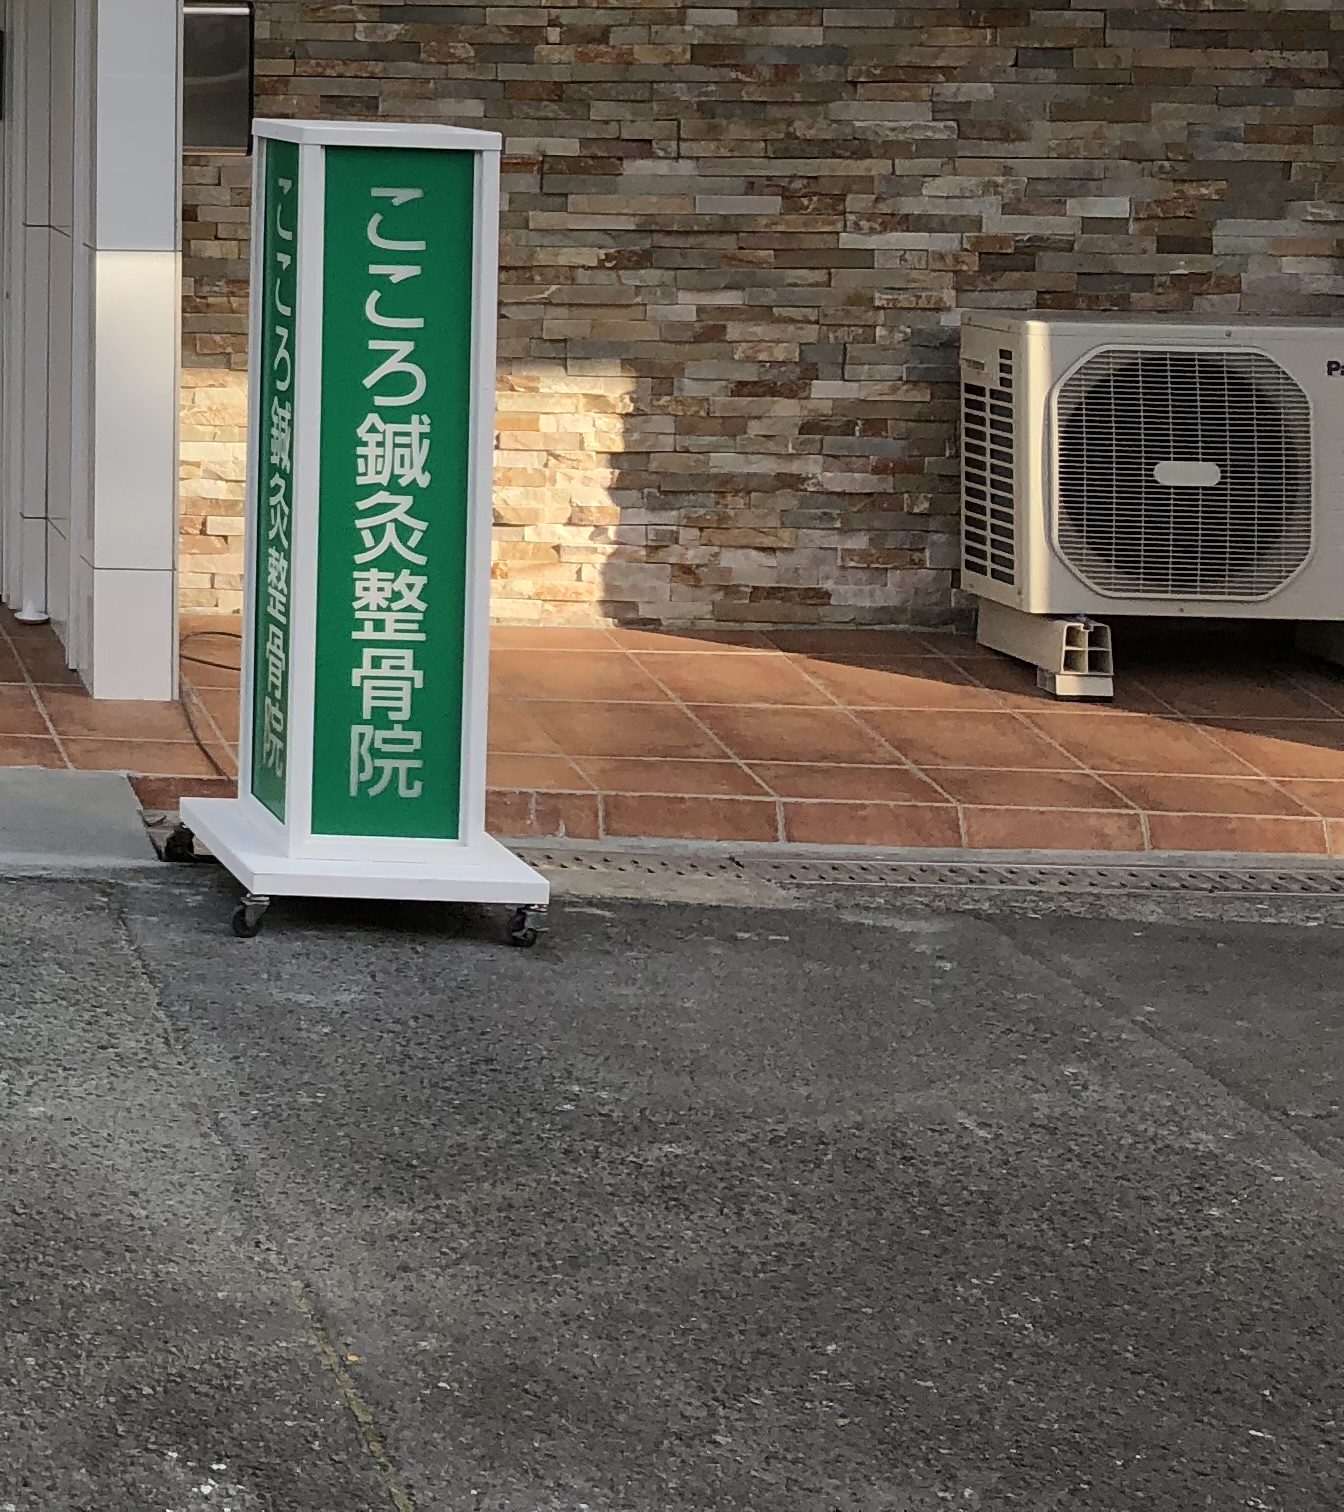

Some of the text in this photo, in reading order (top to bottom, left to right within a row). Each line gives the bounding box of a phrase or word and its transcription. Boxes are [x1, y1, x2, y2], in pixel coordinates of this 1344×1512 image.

[263, 176, 292, 778] こころ鍼灸整骨院
[348, 187, 432, 798] こころ鍼灸整骨院
